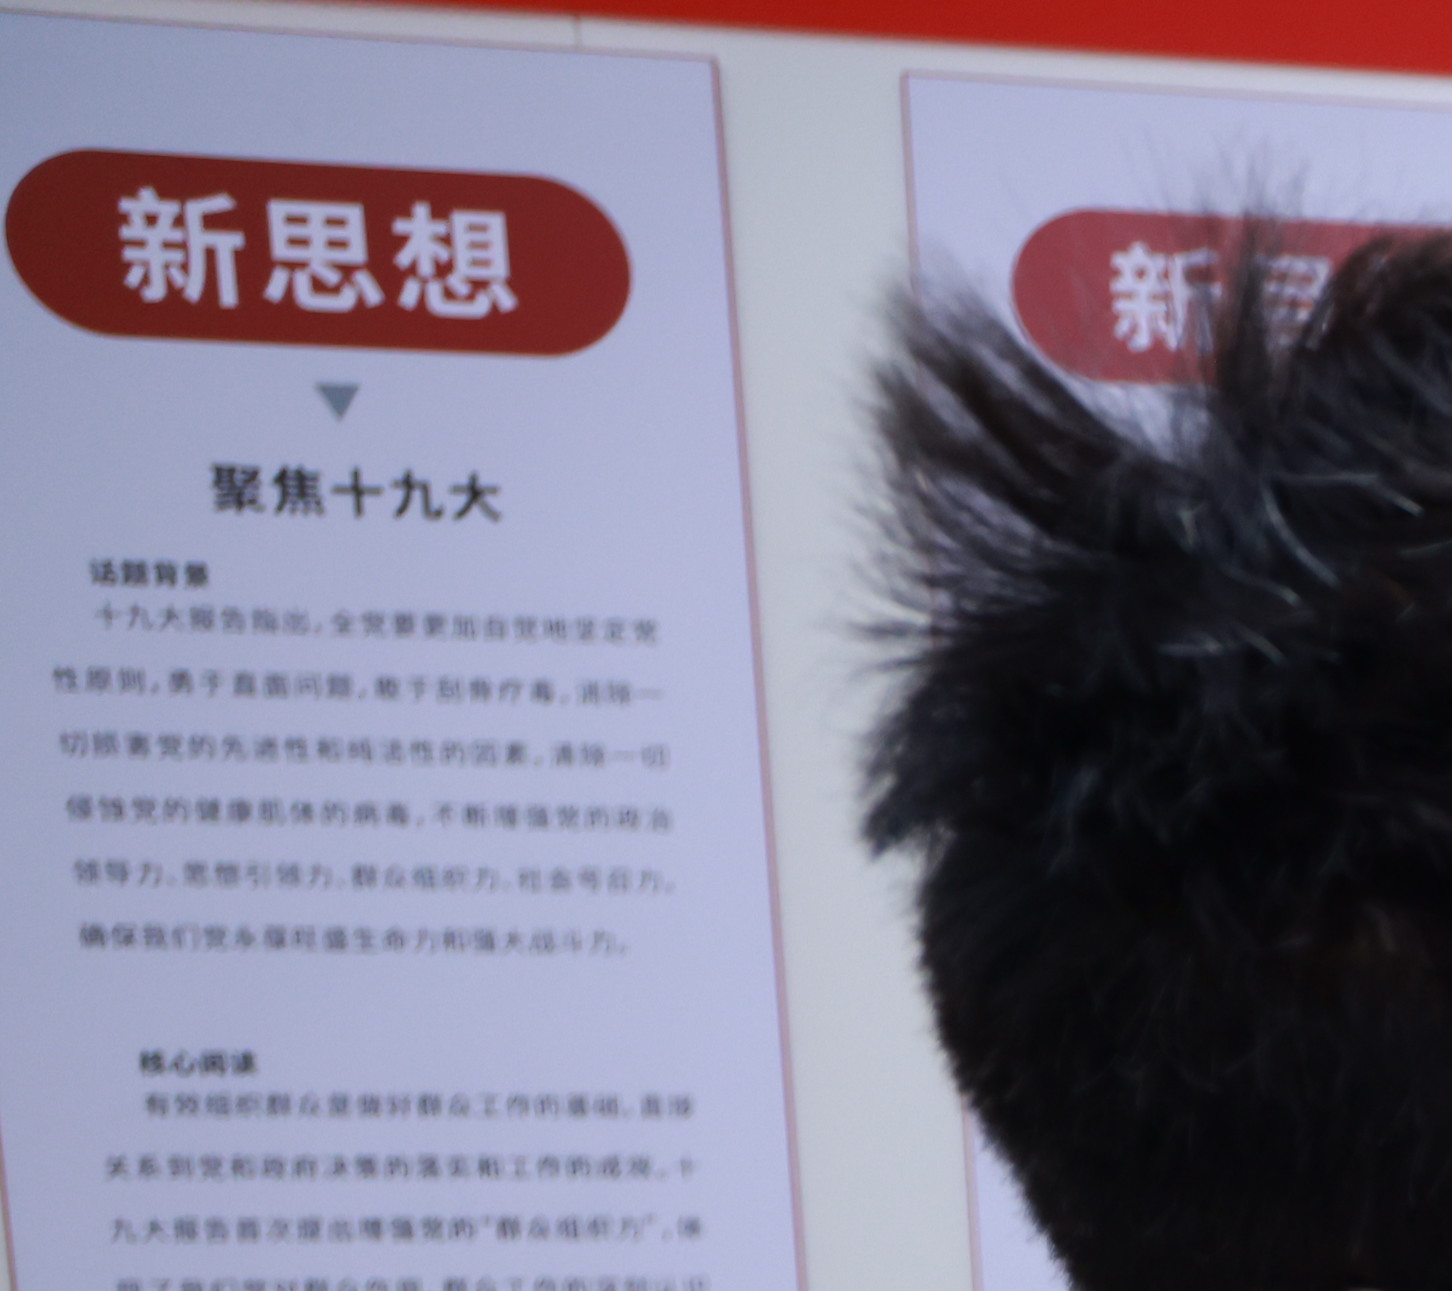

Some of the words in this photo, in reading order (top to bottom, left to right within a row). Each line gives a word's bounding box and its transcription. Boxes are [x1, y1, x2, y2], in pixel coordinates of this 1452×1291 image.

[118, 186, 518, 320] 新思想
[210, 462, 504, 523] 聚焦十九大
[89, 557, 210, 589] 话题背景
